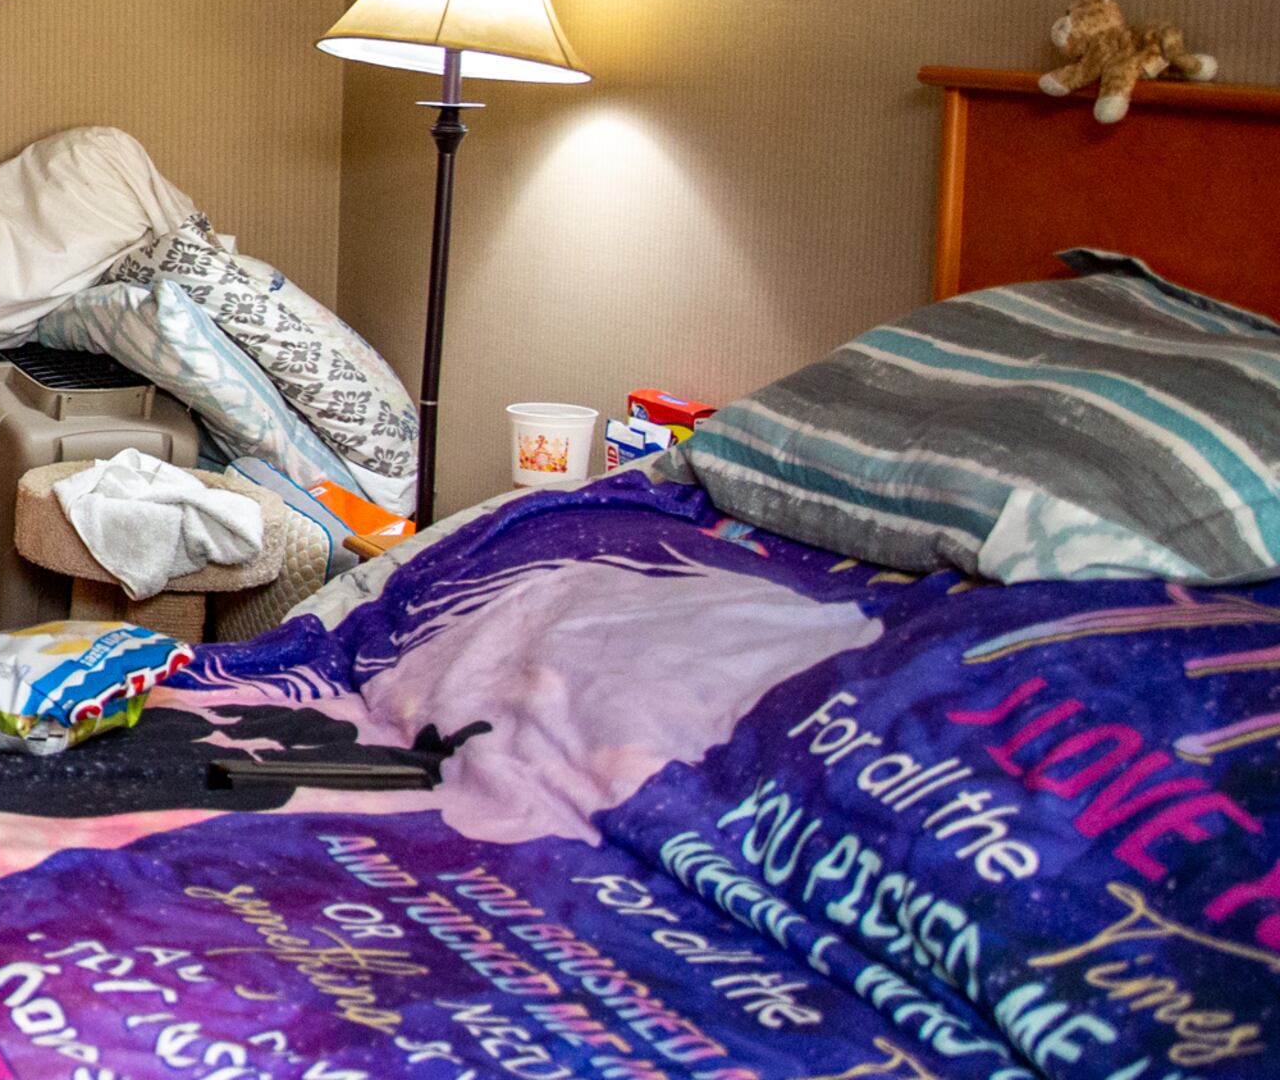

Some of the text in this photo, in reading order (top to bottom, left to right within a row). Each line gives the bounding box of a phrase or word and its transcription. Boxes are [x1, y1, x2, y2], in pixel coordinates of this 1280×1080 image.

[716, 780, 823, 886] YOU
[787, 691, 883, 766] For
[858, 753, 973, 812] all
[922, 790, 1039, 882] the
[986, 697, 1264, 882] LOVE
[183, 884, 429, 1036] something
[316, 835, 419, 888] AND
[388, 891, 561, 996] TUCKED
[522, 1003, 633, 1054] ME
[322, 903, 405, 939] OR
[436, 867, 546, 917] YOU
[507, 923, 729, 1063] BRUSHED
[570, 875, 680, 922] For
[651, 929, 765, 963] all
